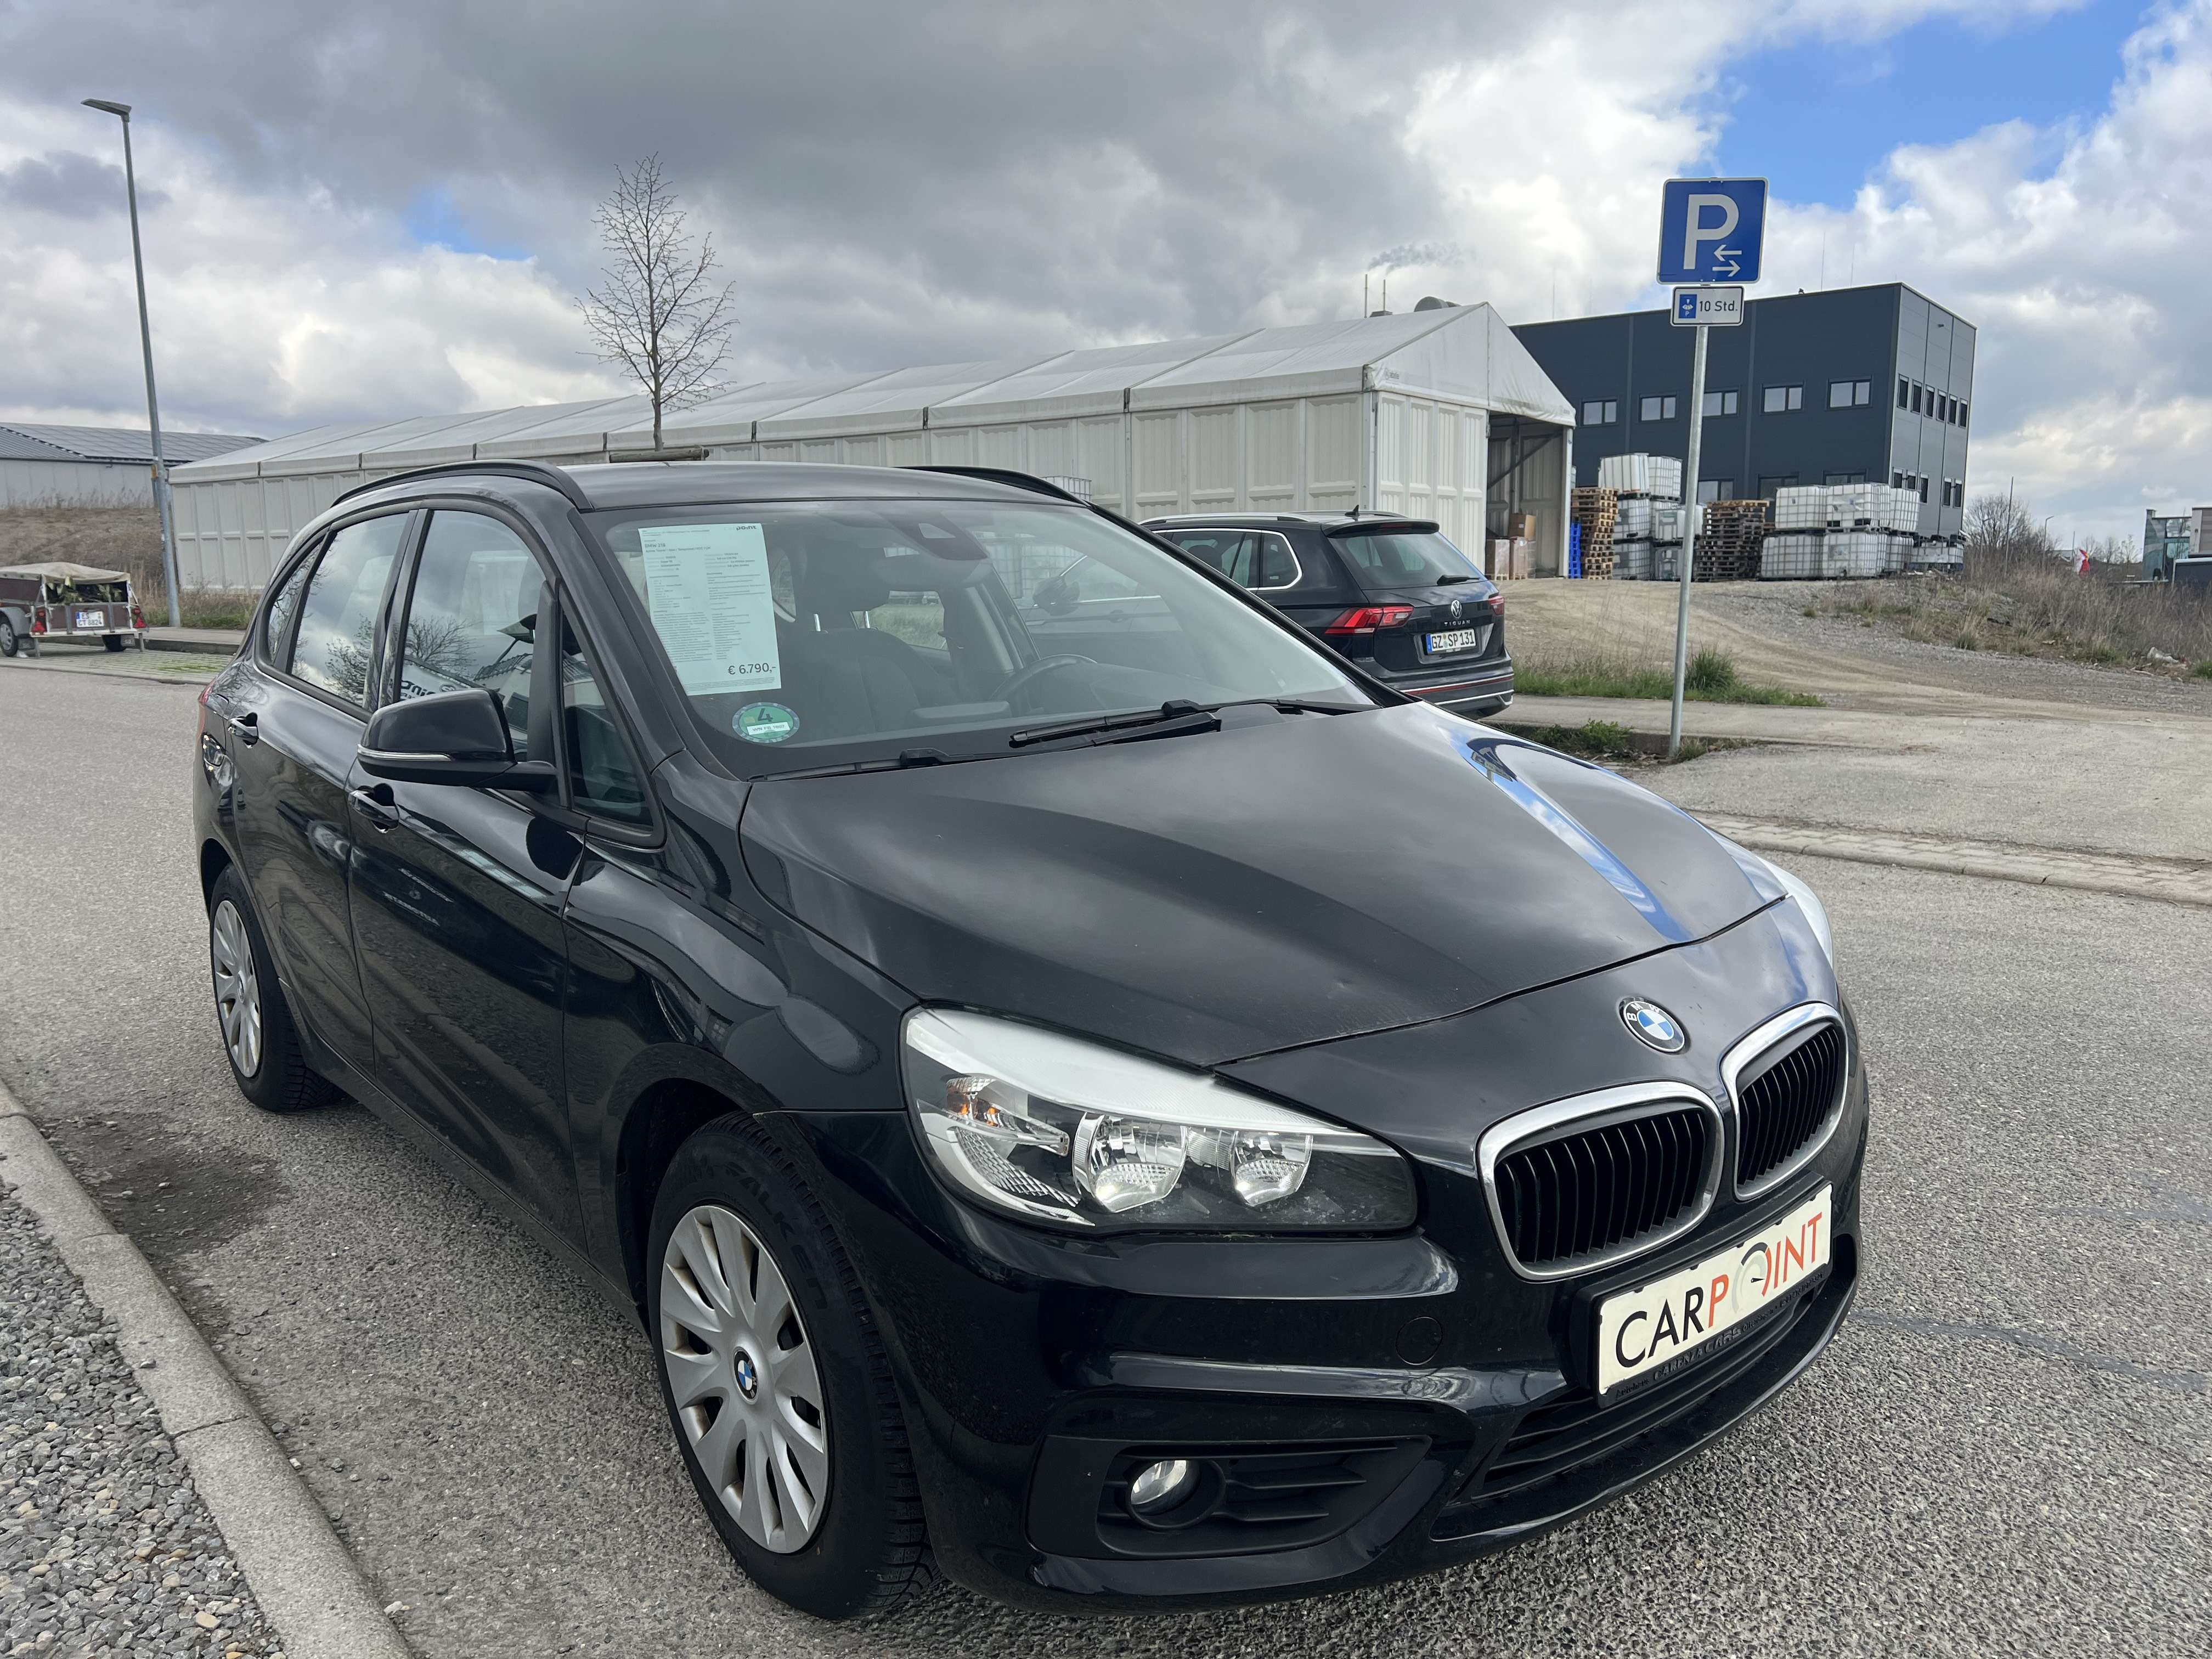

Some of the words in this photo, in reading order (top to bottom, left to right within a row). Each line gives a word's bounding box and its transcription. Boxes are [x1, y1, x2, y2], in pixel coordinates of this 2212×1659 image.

[1683, 194, 1739, 269] P
[1700, 301, 1711, 312] 10
[1714, 300, 1738, 312] Std.
[1431, 635, 1443, 648] GZ
[1448, 633, 1458, 647] SP
[1460, 631, 1475, 646] 131
[728, 665, 736, 675] €
[739, 663, 776, 674] 6.790,-
[758, 708, 773, 722] 4
[1627, 1002, 1660, 1022] BMW
[1615, 1211, 1823, 1368] CARPOINT
[747, 1360, 757, 1398] BMW
